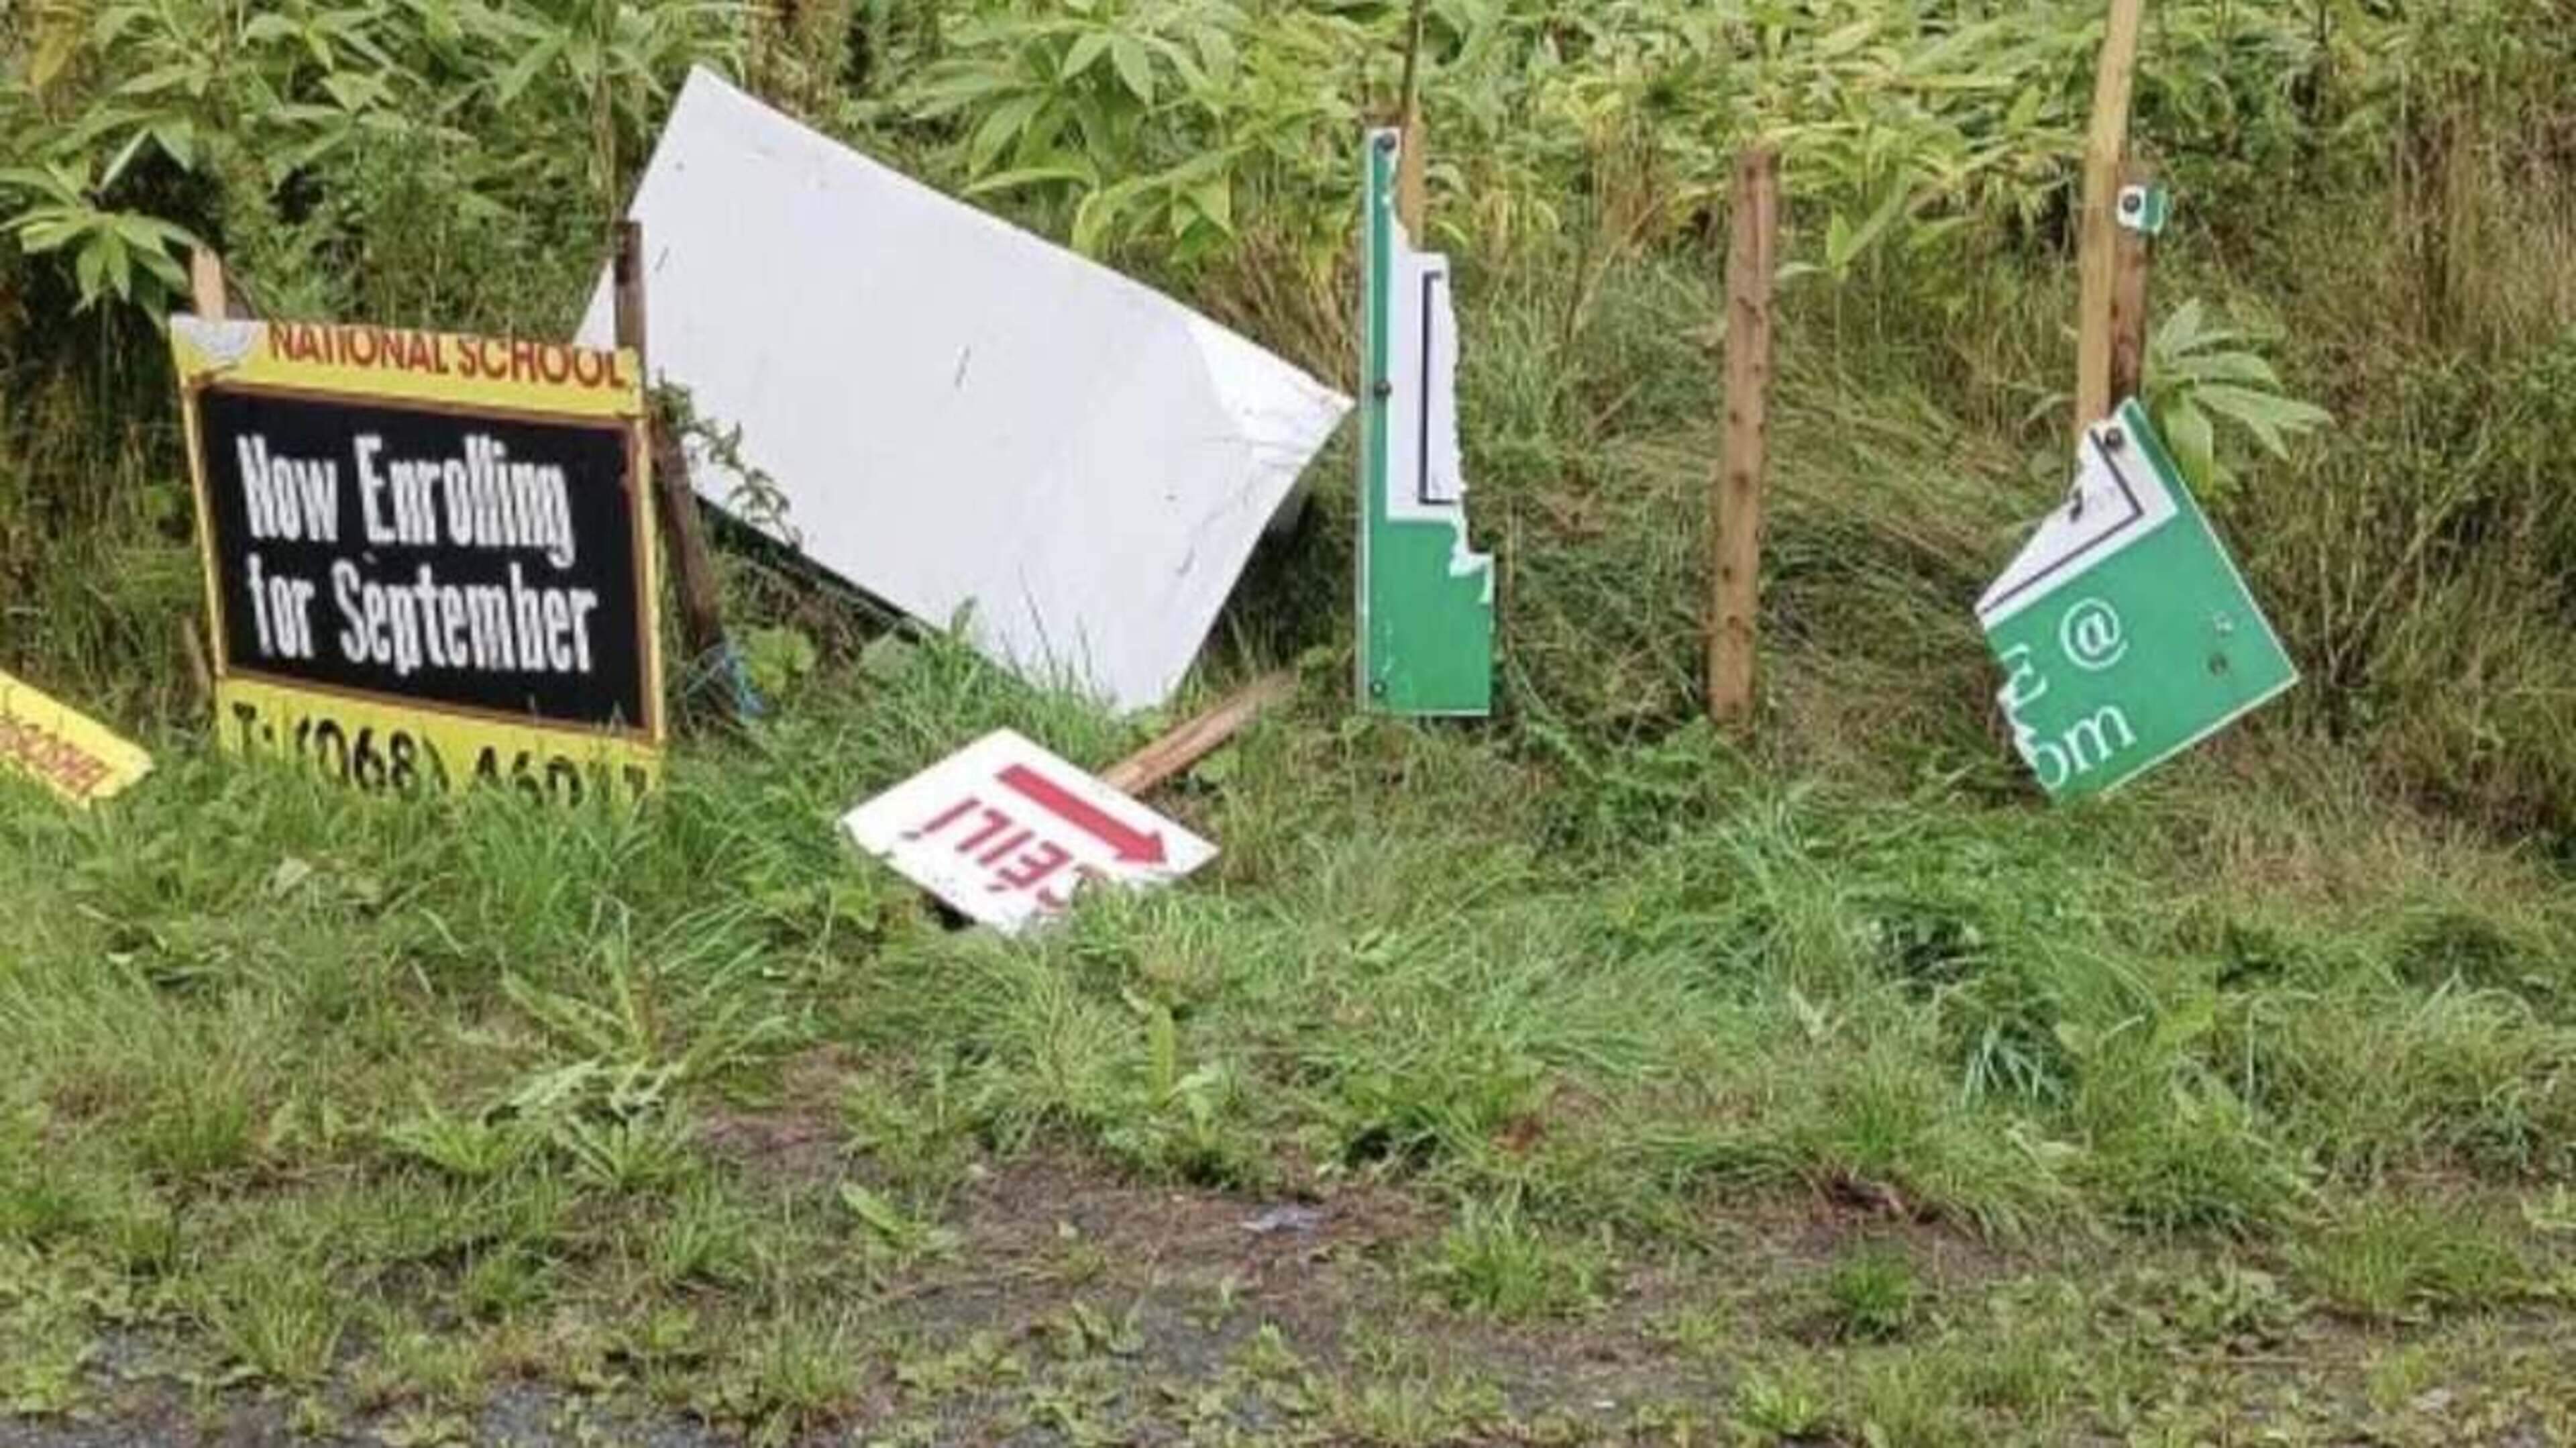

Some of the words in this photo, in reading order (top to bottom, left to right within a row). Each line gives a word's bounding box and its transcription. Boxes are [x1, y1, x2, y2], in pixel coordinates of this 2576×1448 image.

[270, 324, 449, 374] NATIONAL
[458, 338, 627, 388] SCHOOL
[236, 433, 338, 542] Now
[354, 432, 576, 568] Enrolling
[247, 553, 314, 659] for
[331, 558, 598, 675] September
[2059, 597, 2128, 670] @
